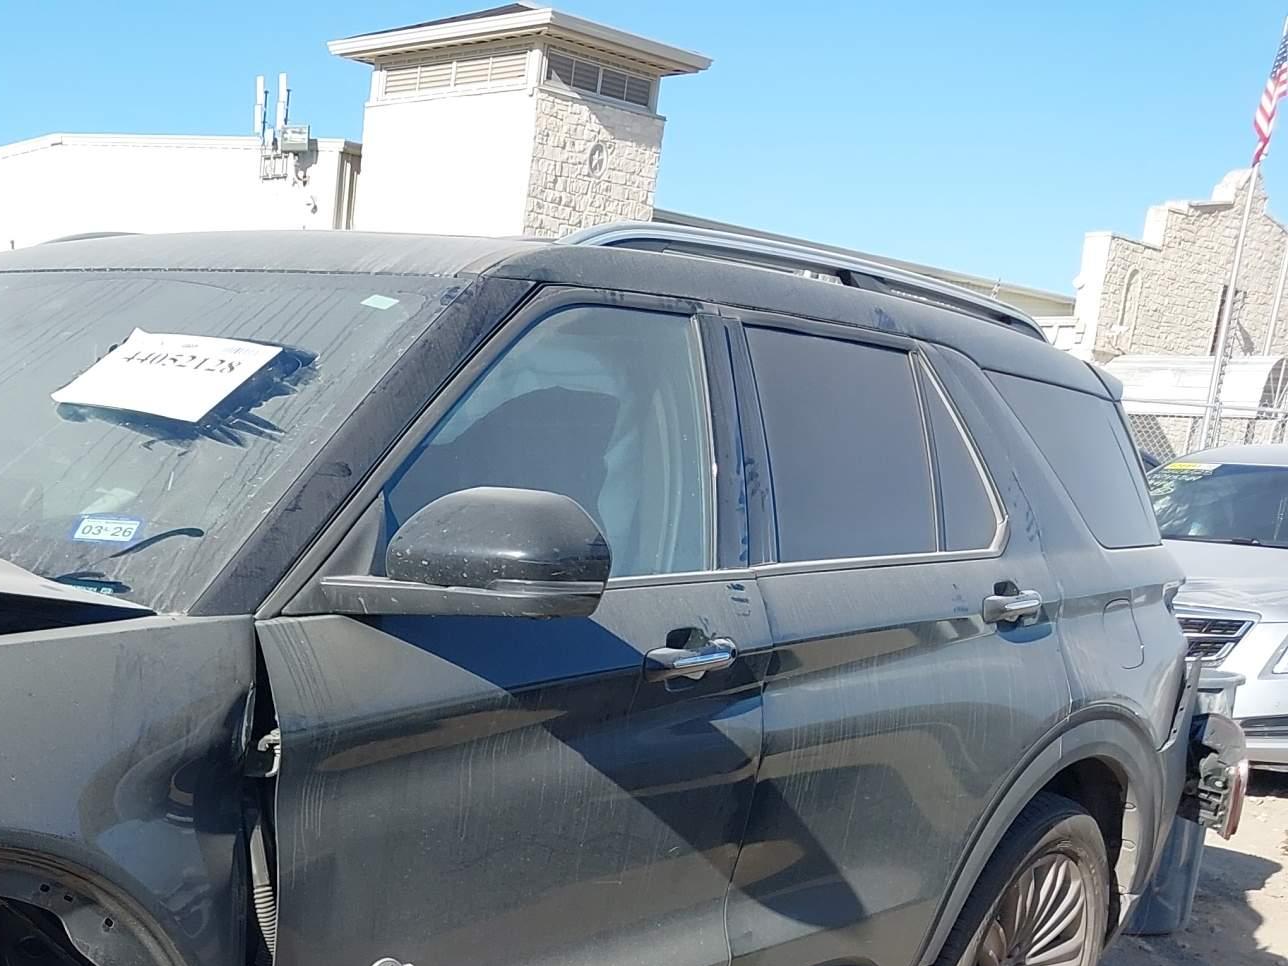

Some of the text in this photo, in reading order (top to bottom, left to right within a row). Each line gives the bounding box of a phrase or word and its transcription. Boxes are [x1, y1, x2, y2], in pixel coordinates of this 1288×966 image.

[122, 351, 242, 374] 44052128
[81, 524, 134, 538] 03 26
